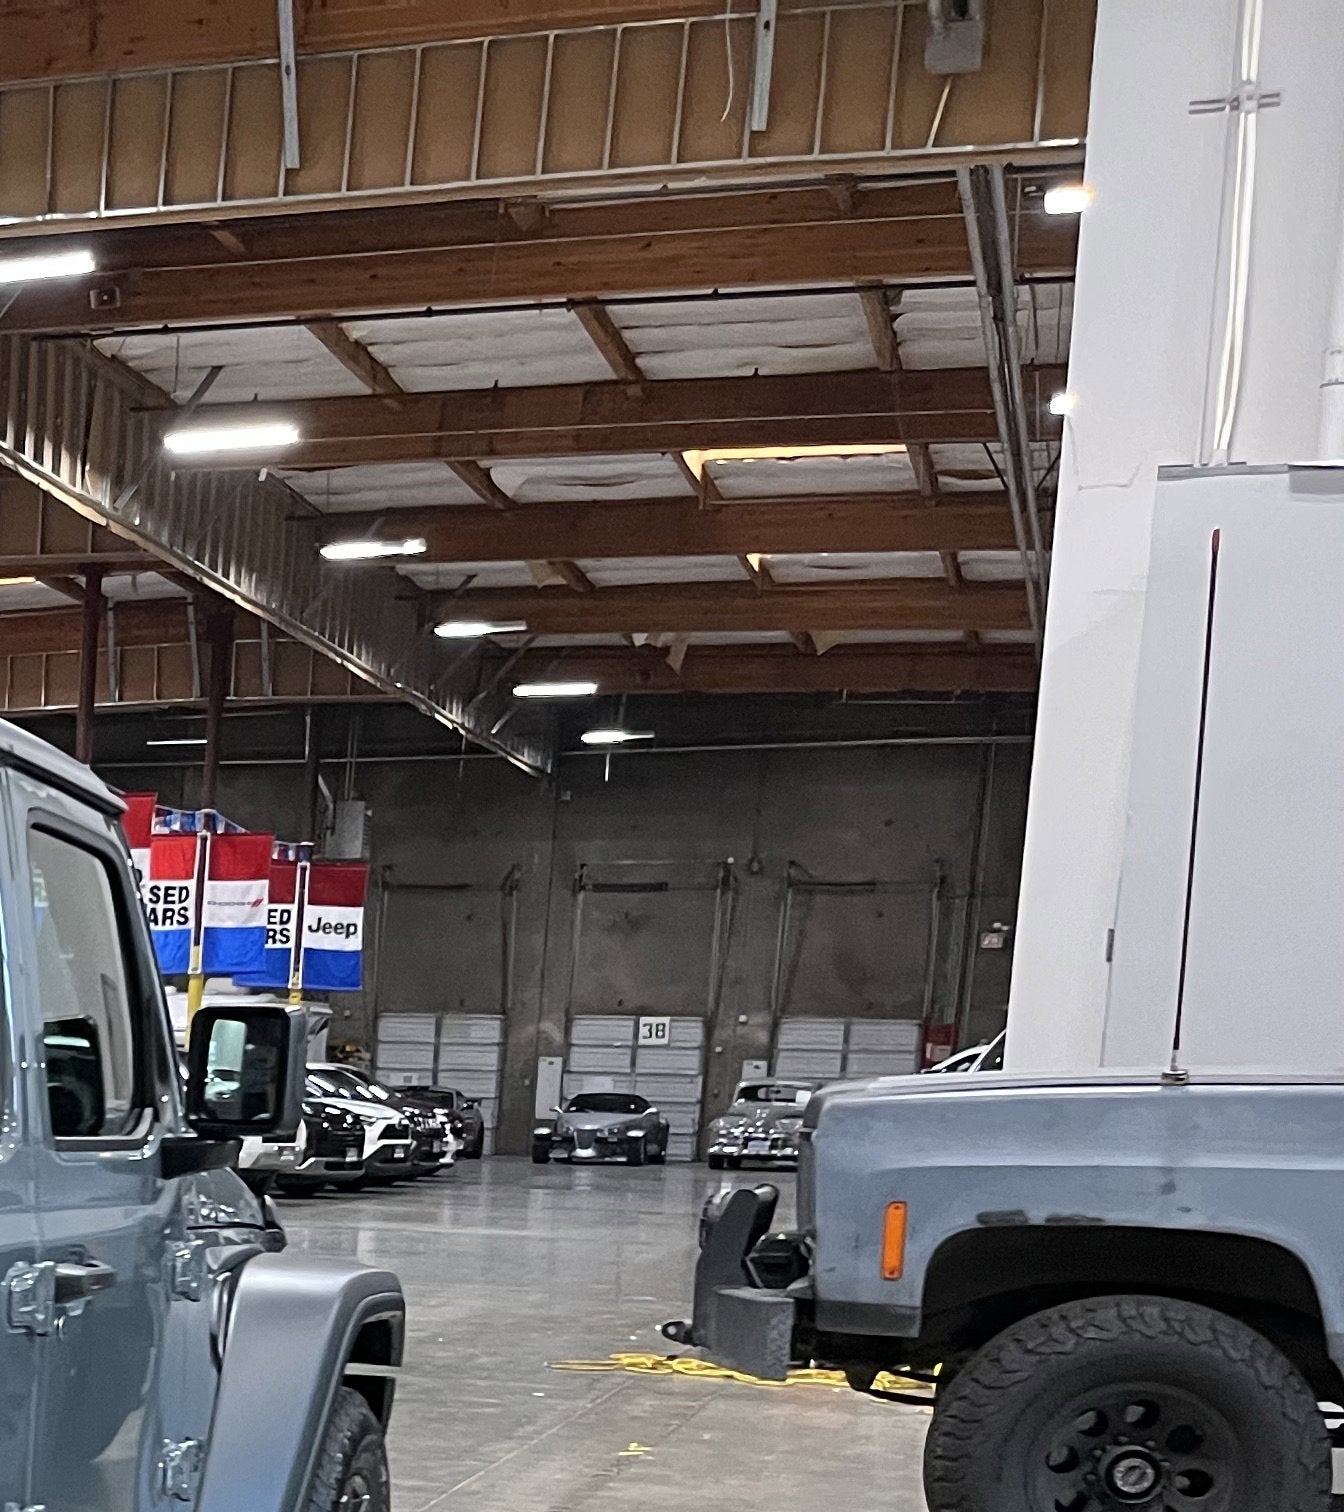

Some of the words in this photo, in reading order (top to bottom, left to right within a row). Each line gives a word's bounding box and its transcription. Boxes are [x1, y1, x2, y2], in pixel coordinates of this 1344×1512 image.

[148, 884, 190, 905] SED
[149, 906, 189, 926] ARS
[267, 908, 291, 926] ED
[266, 928, 291, 945] RS
[307, 917, 358, 939] Jeep
[642, 1022, 666, 1039] 38
